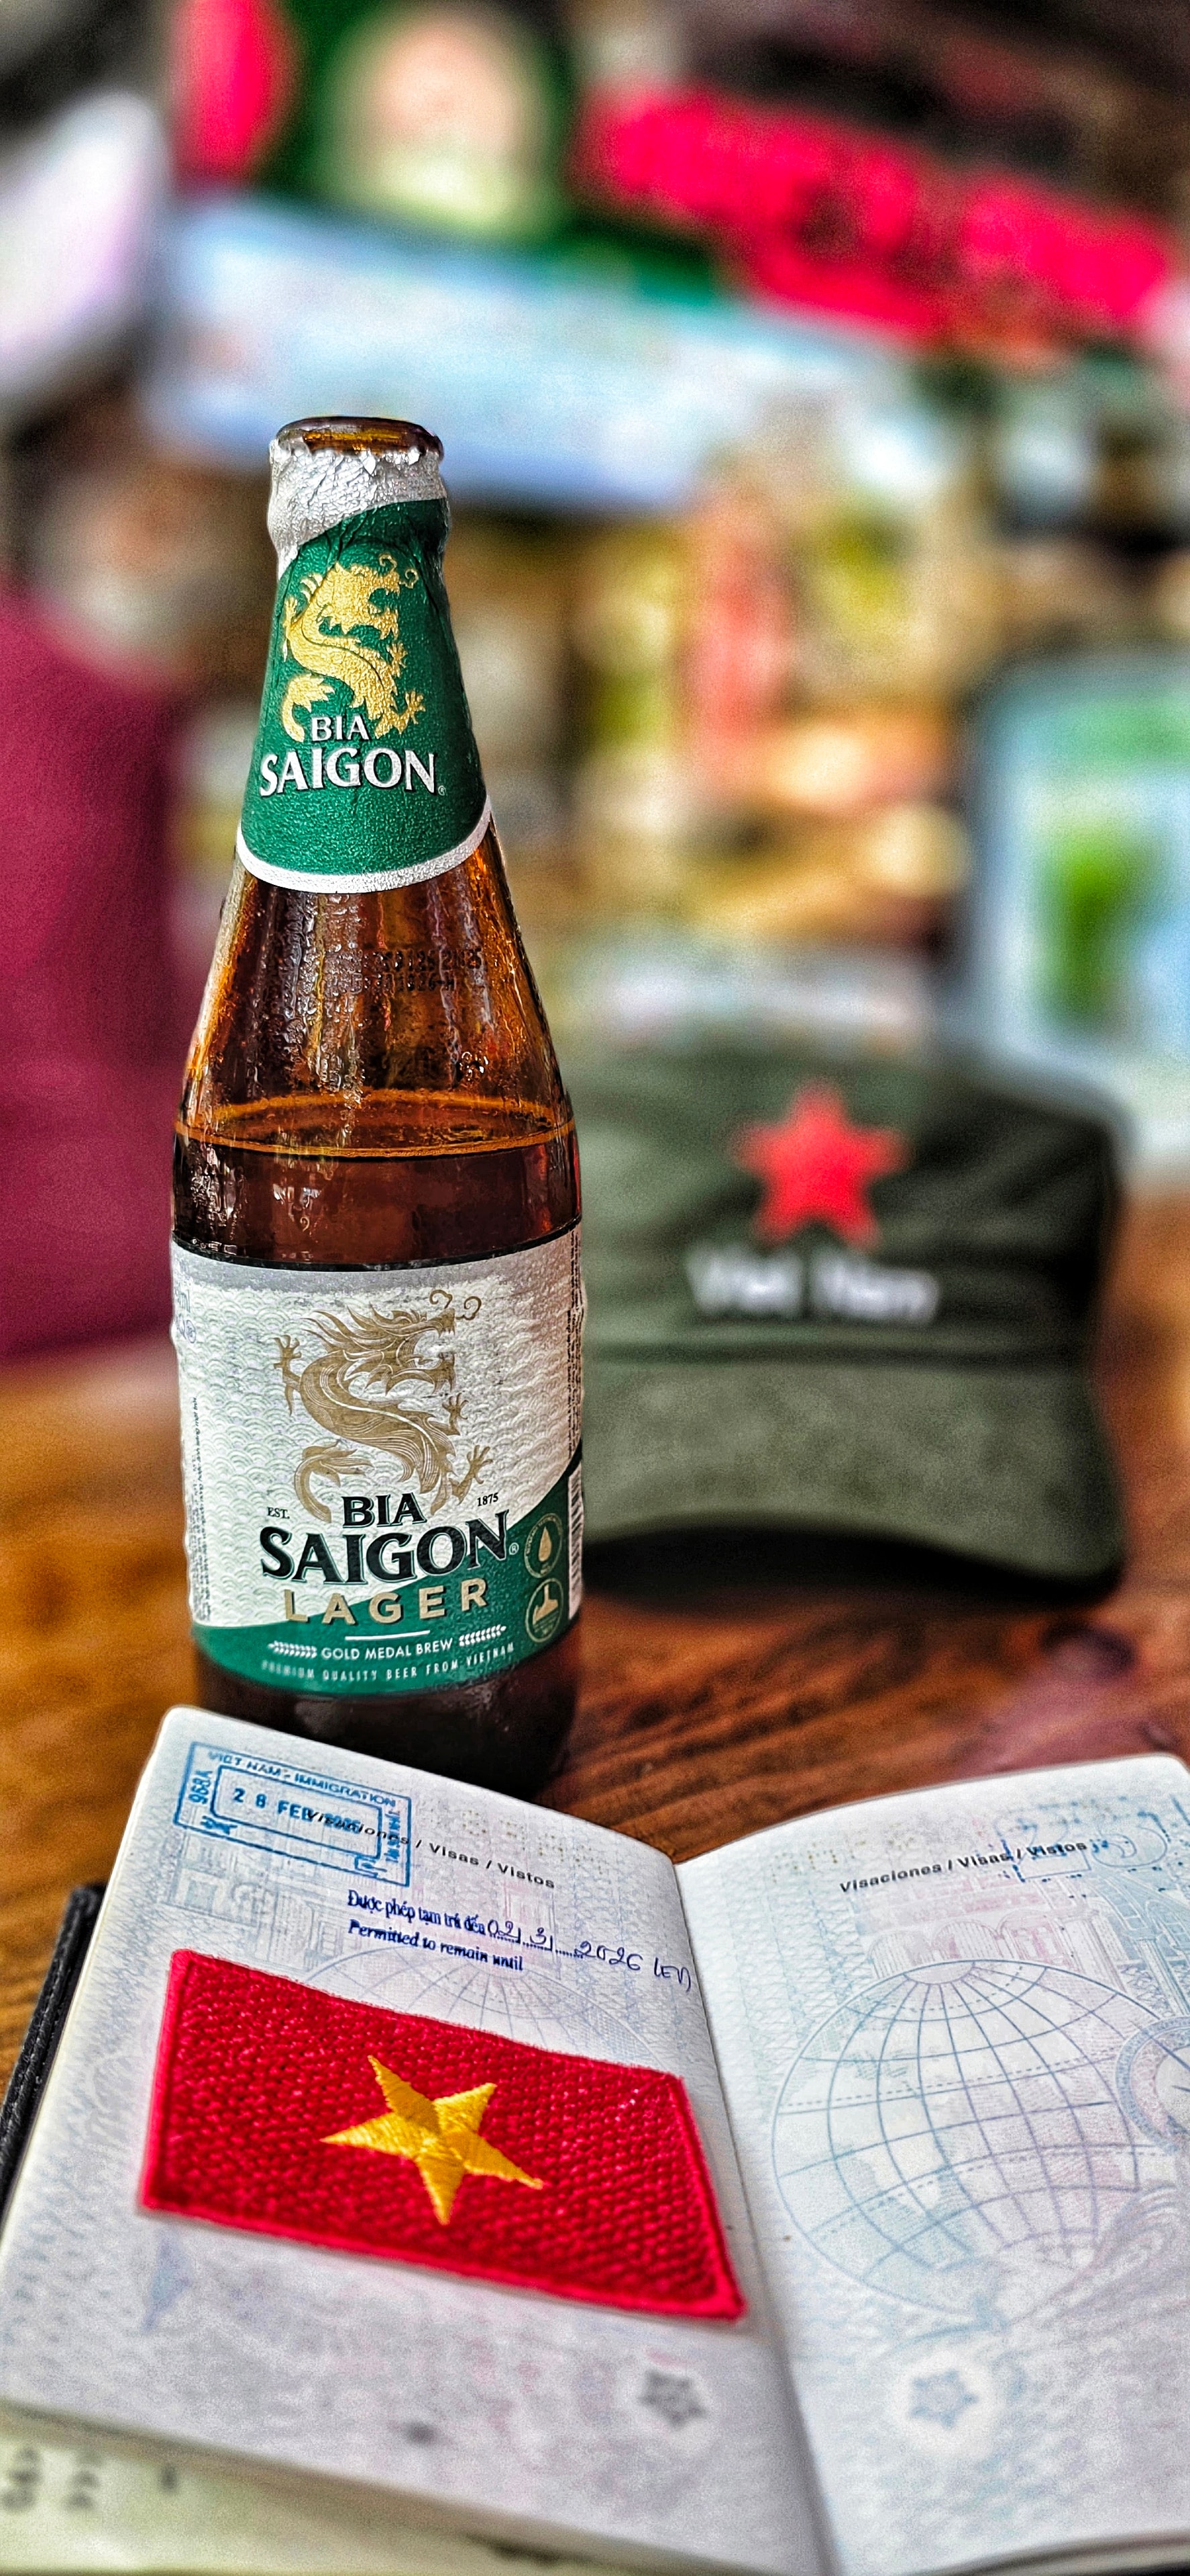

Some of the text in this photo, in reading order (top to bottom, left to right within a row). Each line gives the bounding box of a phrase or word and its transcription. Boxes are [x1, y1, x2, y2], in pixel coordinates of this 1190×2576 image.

[311, 714, 370, 741] BIA
[260, 747, 435, 796] SAIGON
[268, 1493, 499, 1519] EST. 1875
[341, 1493, 427, 1528] BIA
[260, 1509, 509, 1585] SAIGON
[284, 1578, 488, 1625] LAGER
[321, 1638, 453, 1660] GOLD MEDAL BREW
[323, 1669, 377, 1681] QUALITY
[386, 1668, 418, 1680] BEER
[425, 1658, 459, 1676] FROM
[466, 1642, 515, 1667] VIETNAM
[246, 1762, 281, 1777] NAM
[294, 1772, 396, 1807] IMMIGRATION
[430, 1842, 480, 1866] Visas
[498, 1862, 555, 1889] Vistos
[839, 1862, 942, 1893] Visaciones
[956, 1851, 1012, 1870] Visas
[1026, 1839, 1088, 1859] Vistos
[347, 1919, 523, 1971] Permitted to remain until
